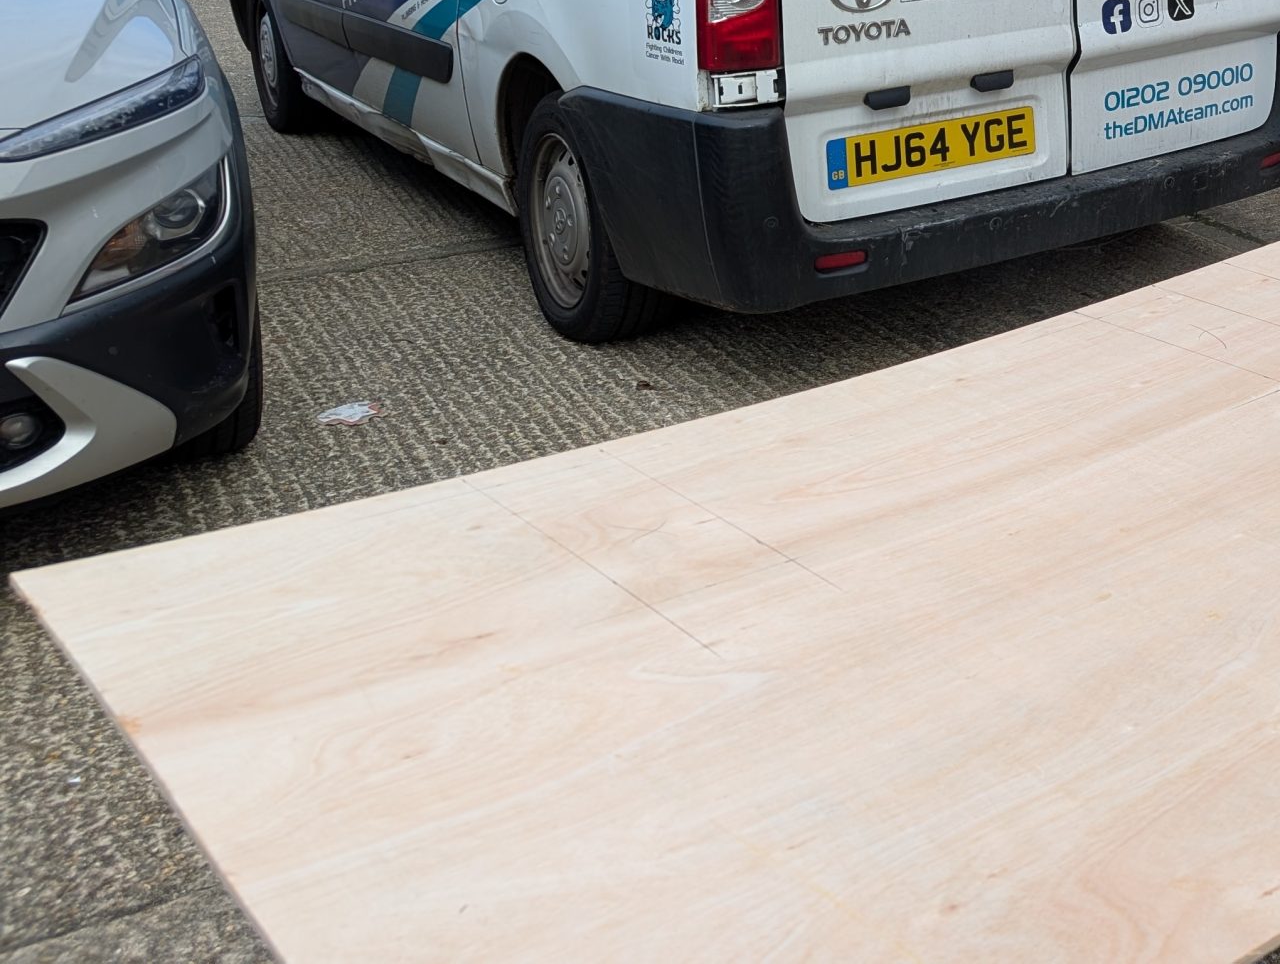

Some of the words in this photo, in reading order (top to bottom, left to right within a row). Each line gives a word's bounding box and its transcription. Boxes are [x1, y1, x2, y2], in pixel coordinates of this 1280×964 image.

[647, 24, 681, 45] ROCKS
[818, 17, 911, 46] TOYOTA
[1104, 81, 1170, 112] 01202
[1178, 62, 1254, 96] 090010
[1104, 94, 1254, 140] theDMAteam.com
[854, 127, 950, 178] HJ64
[961, 113, 1028, 157] YGE
[831, 169, 845, 181] GB
